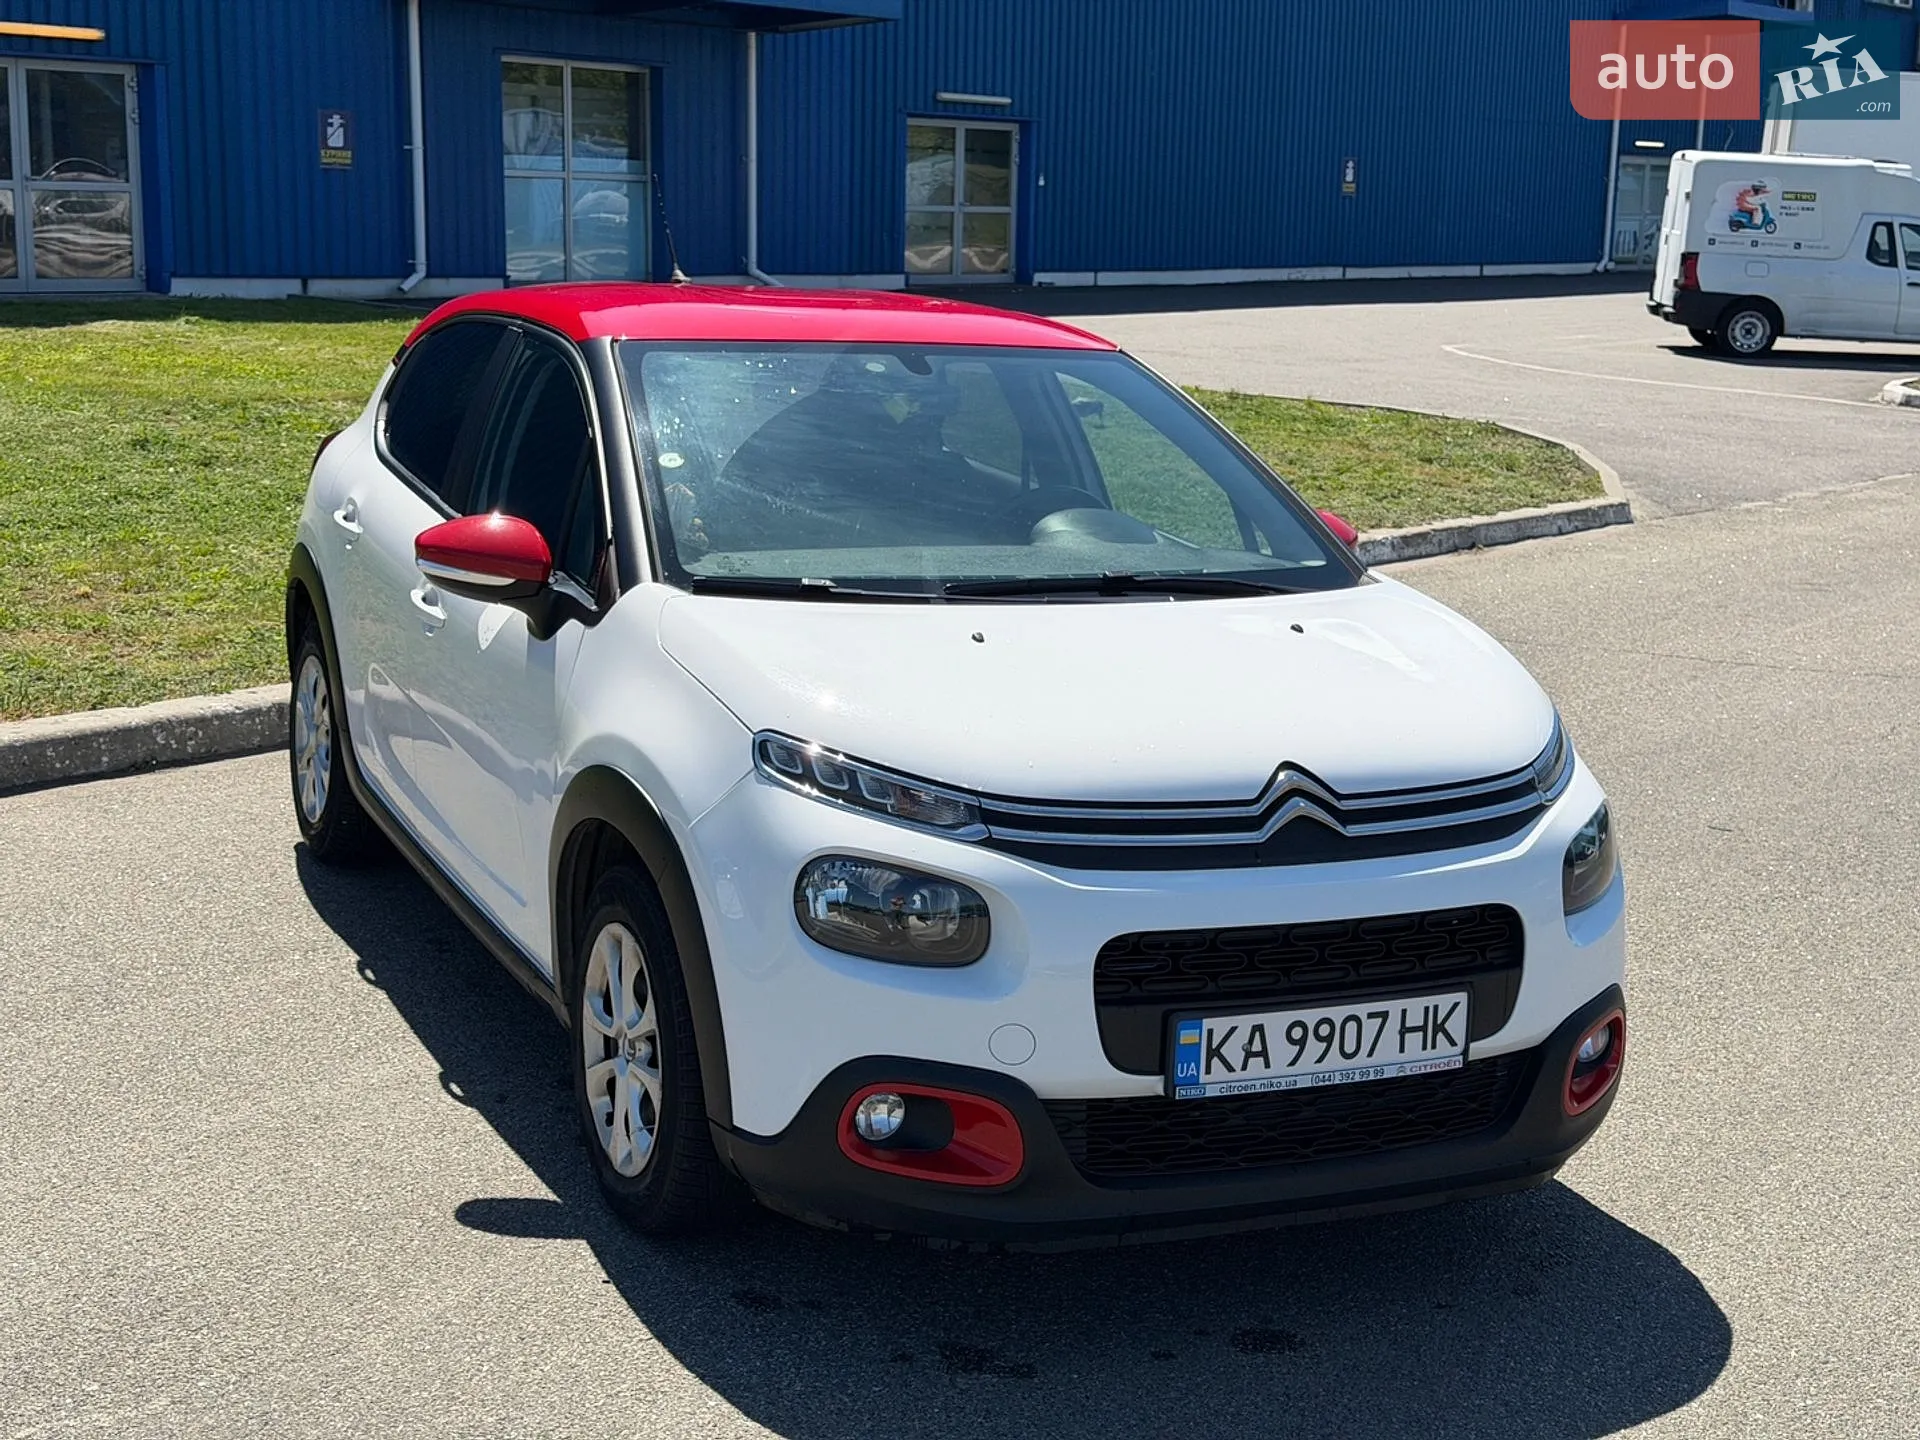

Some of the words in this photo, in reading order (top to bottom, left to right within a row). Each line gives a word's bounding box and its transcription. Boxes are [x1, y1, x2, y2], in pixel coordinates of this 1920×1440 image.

[1783, 192, 1815, 201] METRO
[1204, 1023, 1271, 1075] KA
[1285, 1010, 1389, 1067] 9907
[1398, 1001, 1460, 1053] HK
[1177, 1062, 1197, 1078] UA
[1310, 1074, 1336, 1086] (044)
[1338, 1071, 1356, 1082] 392
[1358, 1069, 1371, 1079] 99
[1373, 1067, 1385, 1077] 99
[1180, 1088, 1205, 1096] NIKO
[1218, 1079, 1298, 1094] citroen.niko.ua
